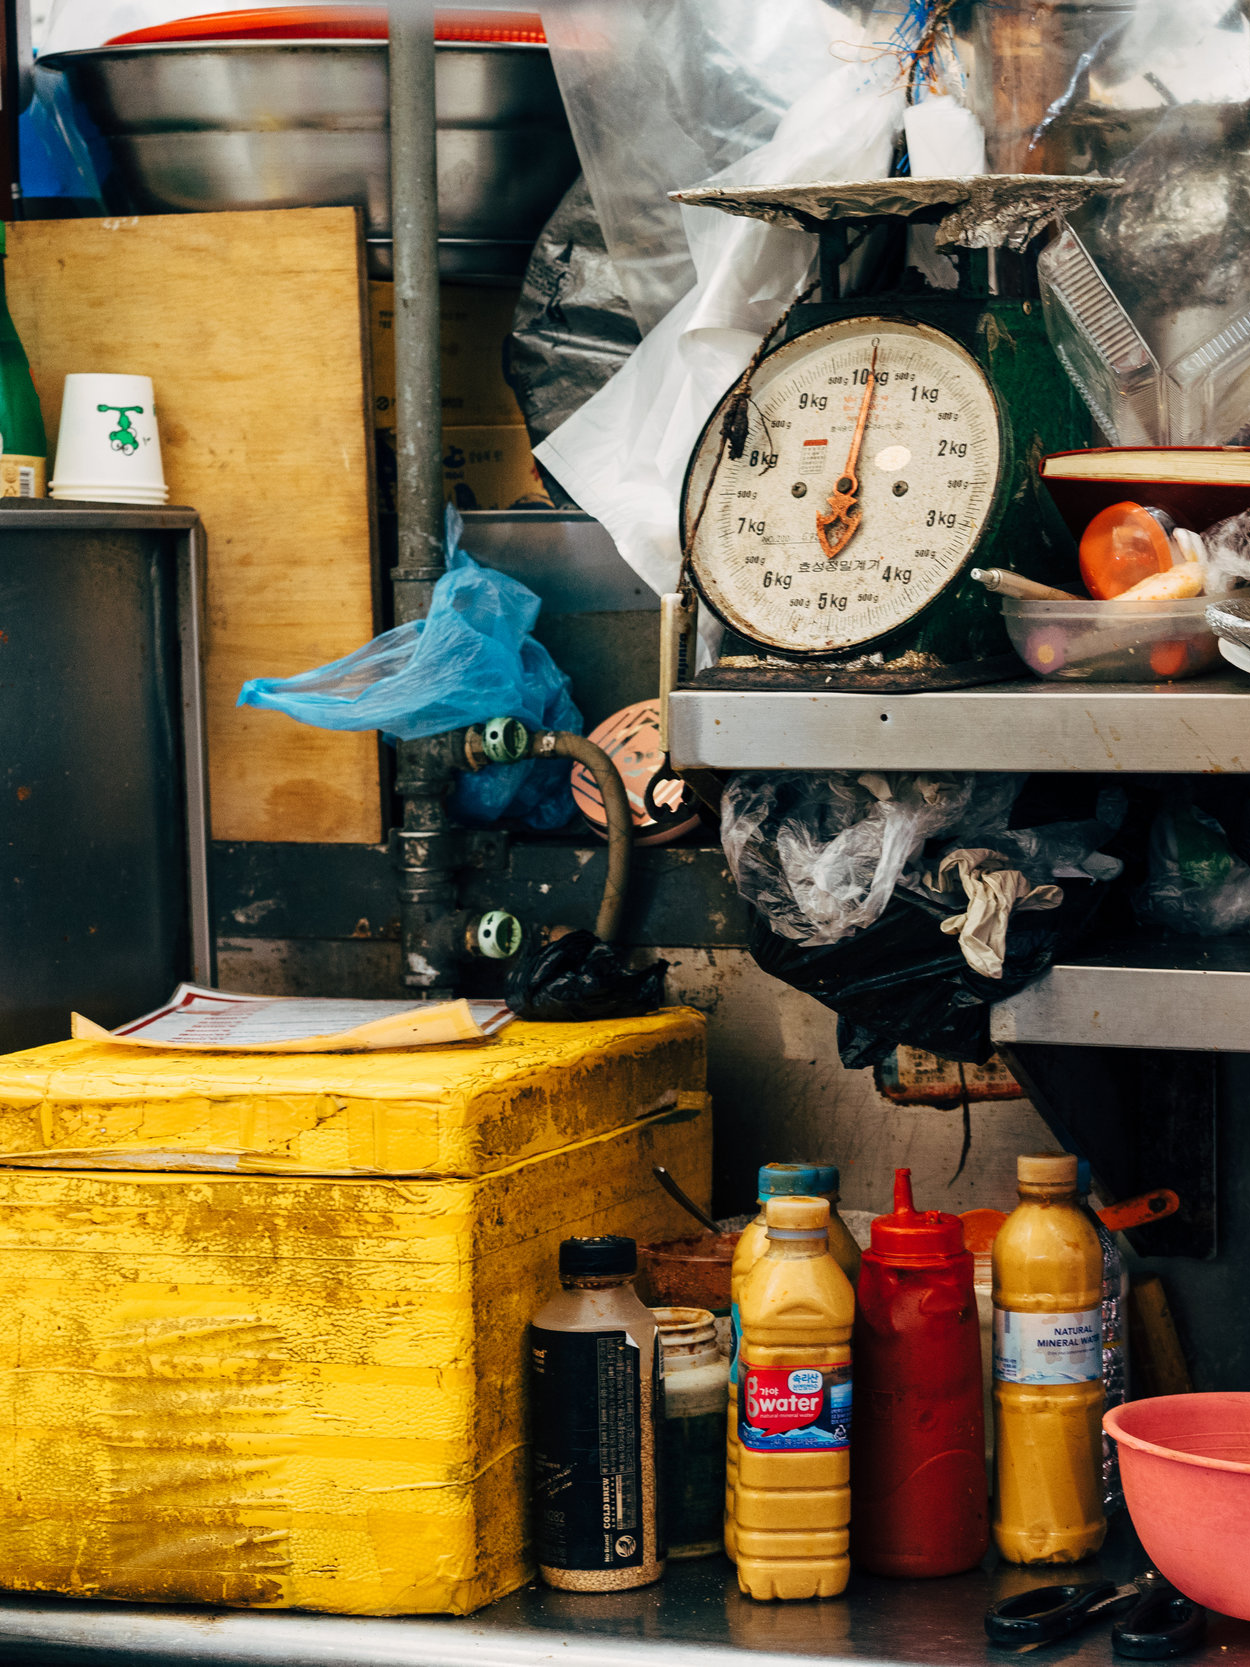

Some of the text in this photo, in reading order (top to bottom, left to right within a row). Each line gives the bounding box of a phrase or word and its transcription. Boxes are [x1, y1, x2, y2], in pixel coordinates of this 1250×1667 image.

[798, 559, 881, 573] 효성정밀계기
[1054, 1325, 1094, 1336] NATURAL
[1037, 1338, 1079, 1348] MINERAL
[759, 1387, 780, 1397] 가야
[759, 1395, 820, 1412] water
[602, 1477, 611, 1530] COLD BREW
[604, 1553, 611, 1563] No
